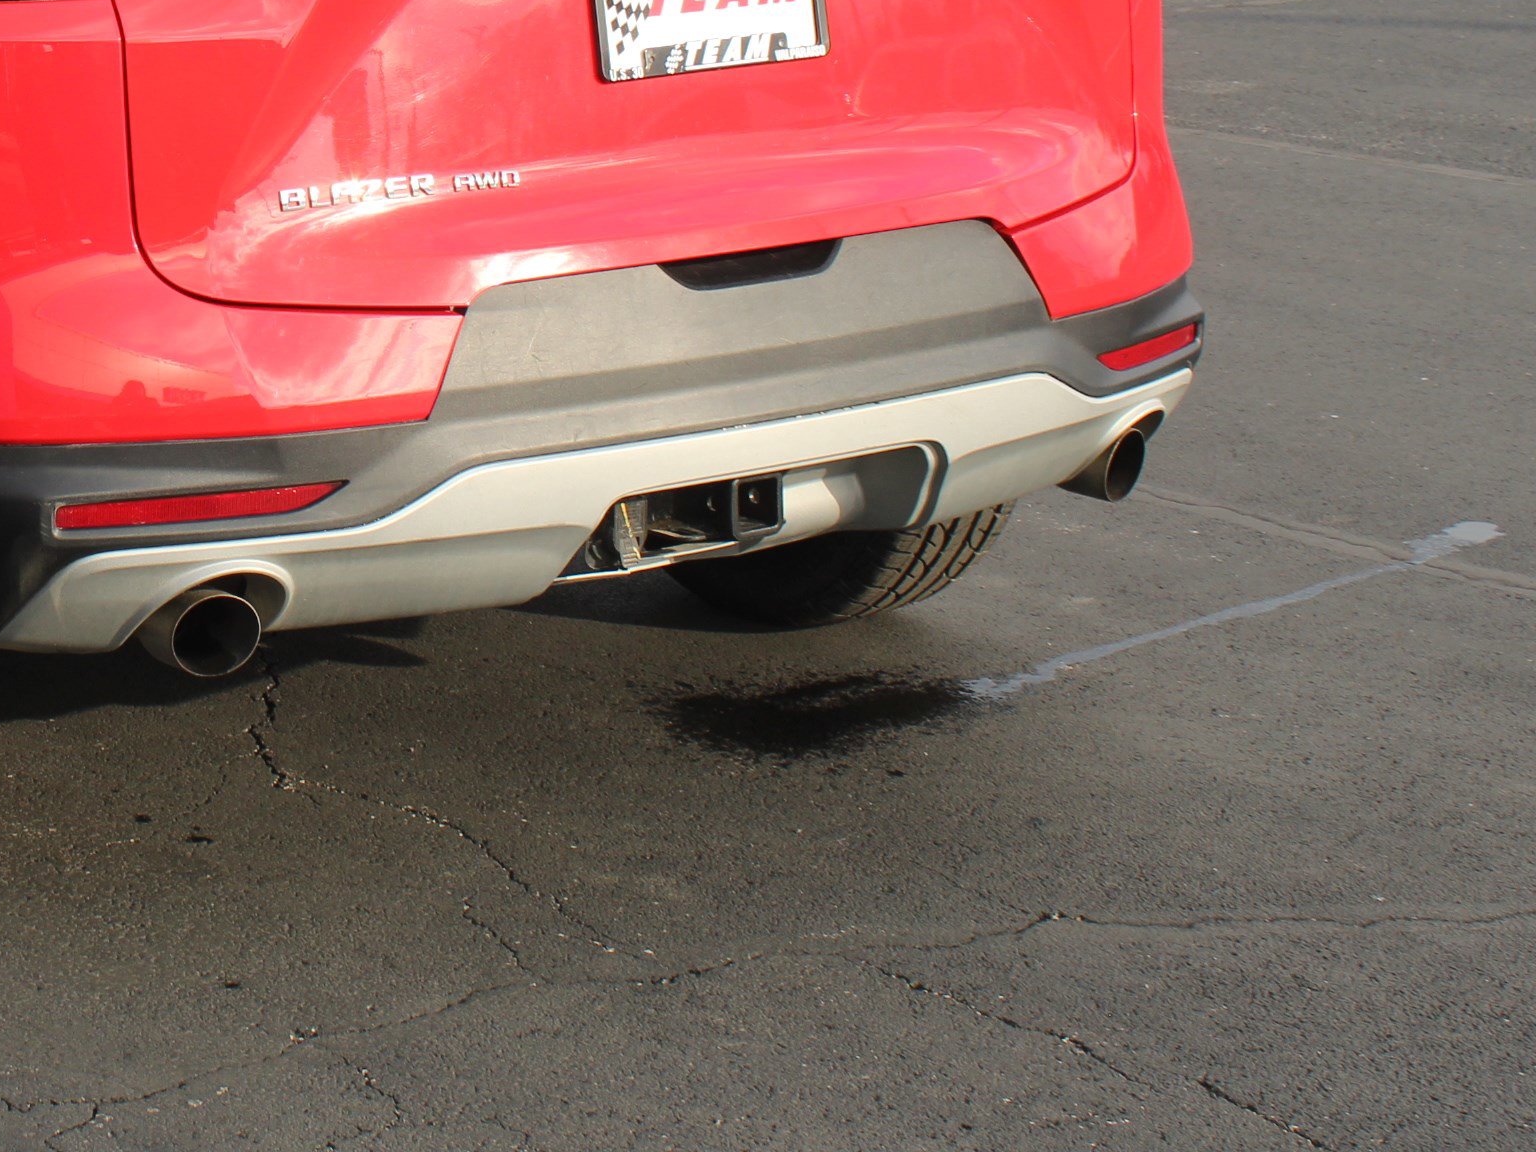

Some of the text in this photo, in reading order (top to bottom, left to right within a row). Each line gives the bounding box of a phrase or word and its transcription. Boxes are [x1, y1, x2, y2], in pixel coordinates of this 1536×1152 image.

[685, 32, 773, 68] TEAM
[774, 44, 827, 62] VALPARAISO
[632, 66, 645, 79] 30
[278, 169, 521, 212] BLAZER AWD
